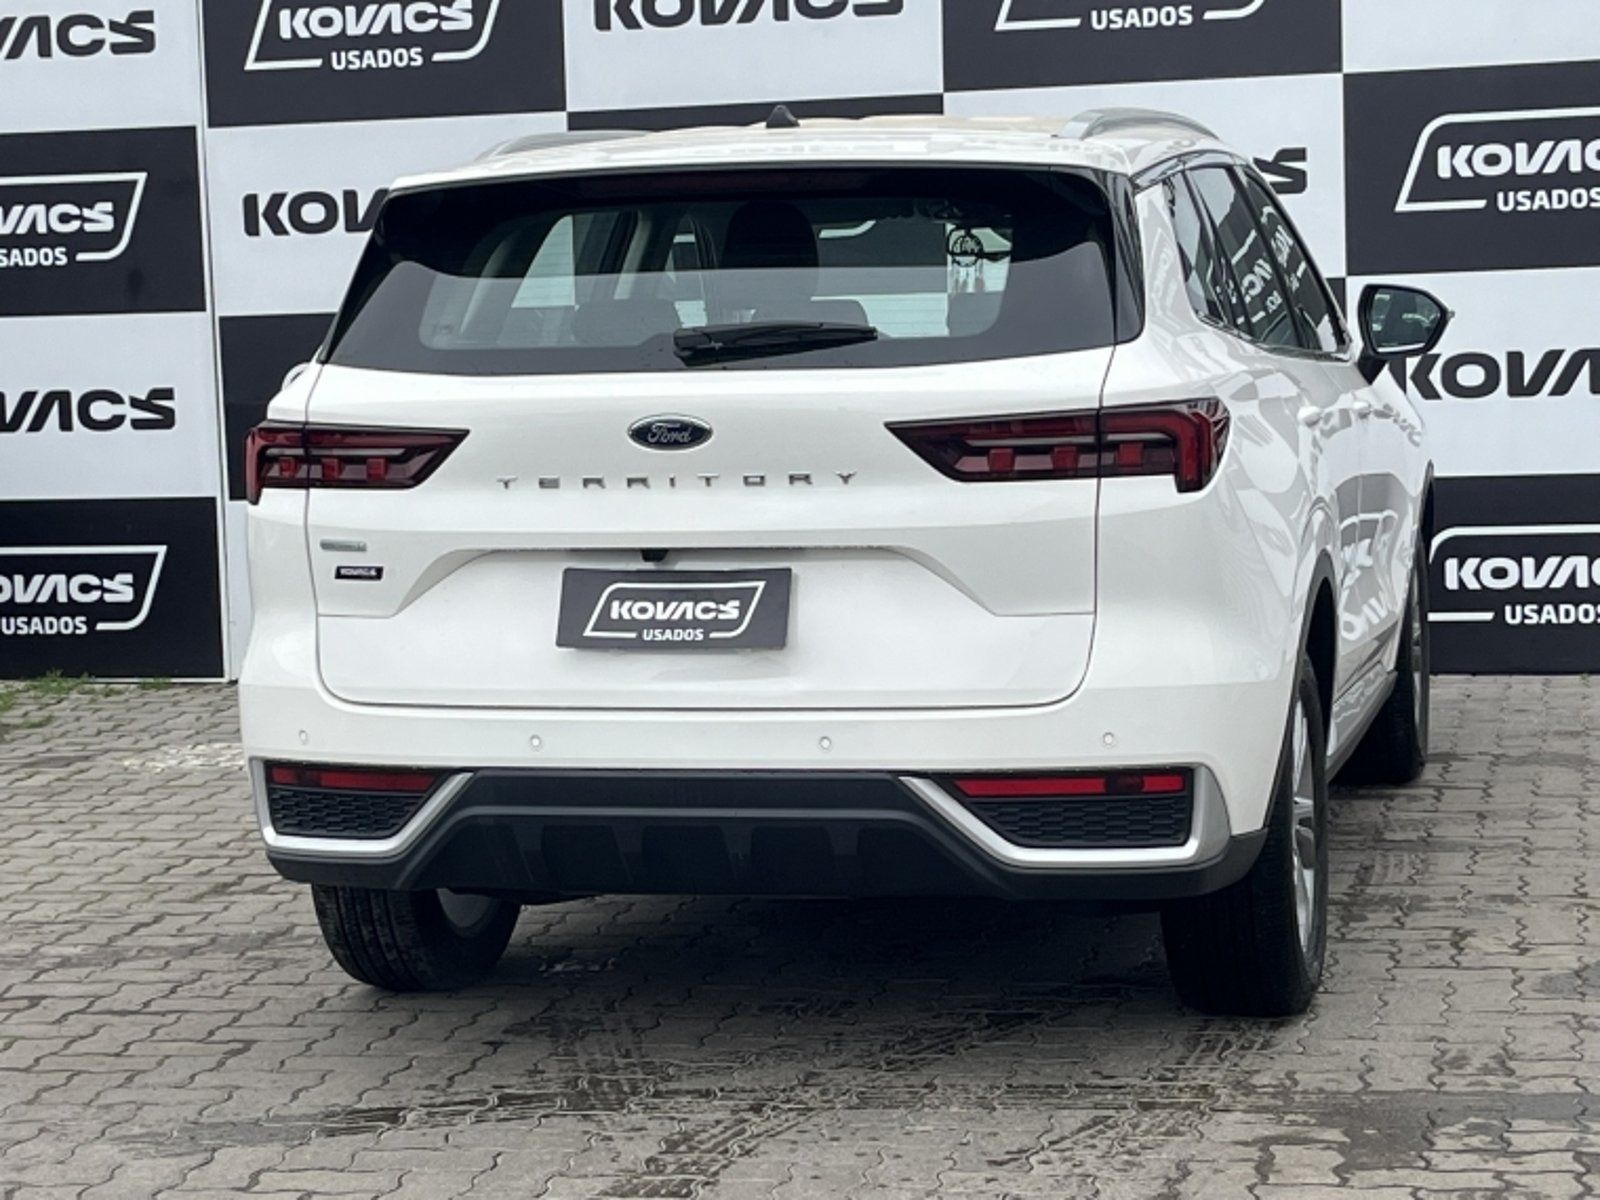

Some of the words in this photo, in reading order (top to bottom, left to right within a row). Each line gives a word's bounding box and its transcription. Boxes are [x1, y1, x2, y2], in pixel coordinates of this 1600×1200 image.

[279, 1, 473, 39] KOVACS
[1091, 5, 1193, 30] USADOS
[331, 47, 424, 70] USADOS
[647, 422, 692, 443] Ford
[497, 472, 856, 489] TERRITORY
[1445, 555, 1600, 590] KOVA
[610, 600, 741, 620] KOVACS
[1504, 604, 1600, 625] USADO
[1, 616, 88, 634] USADOS
[643, 629, 704, 641] USADOS
